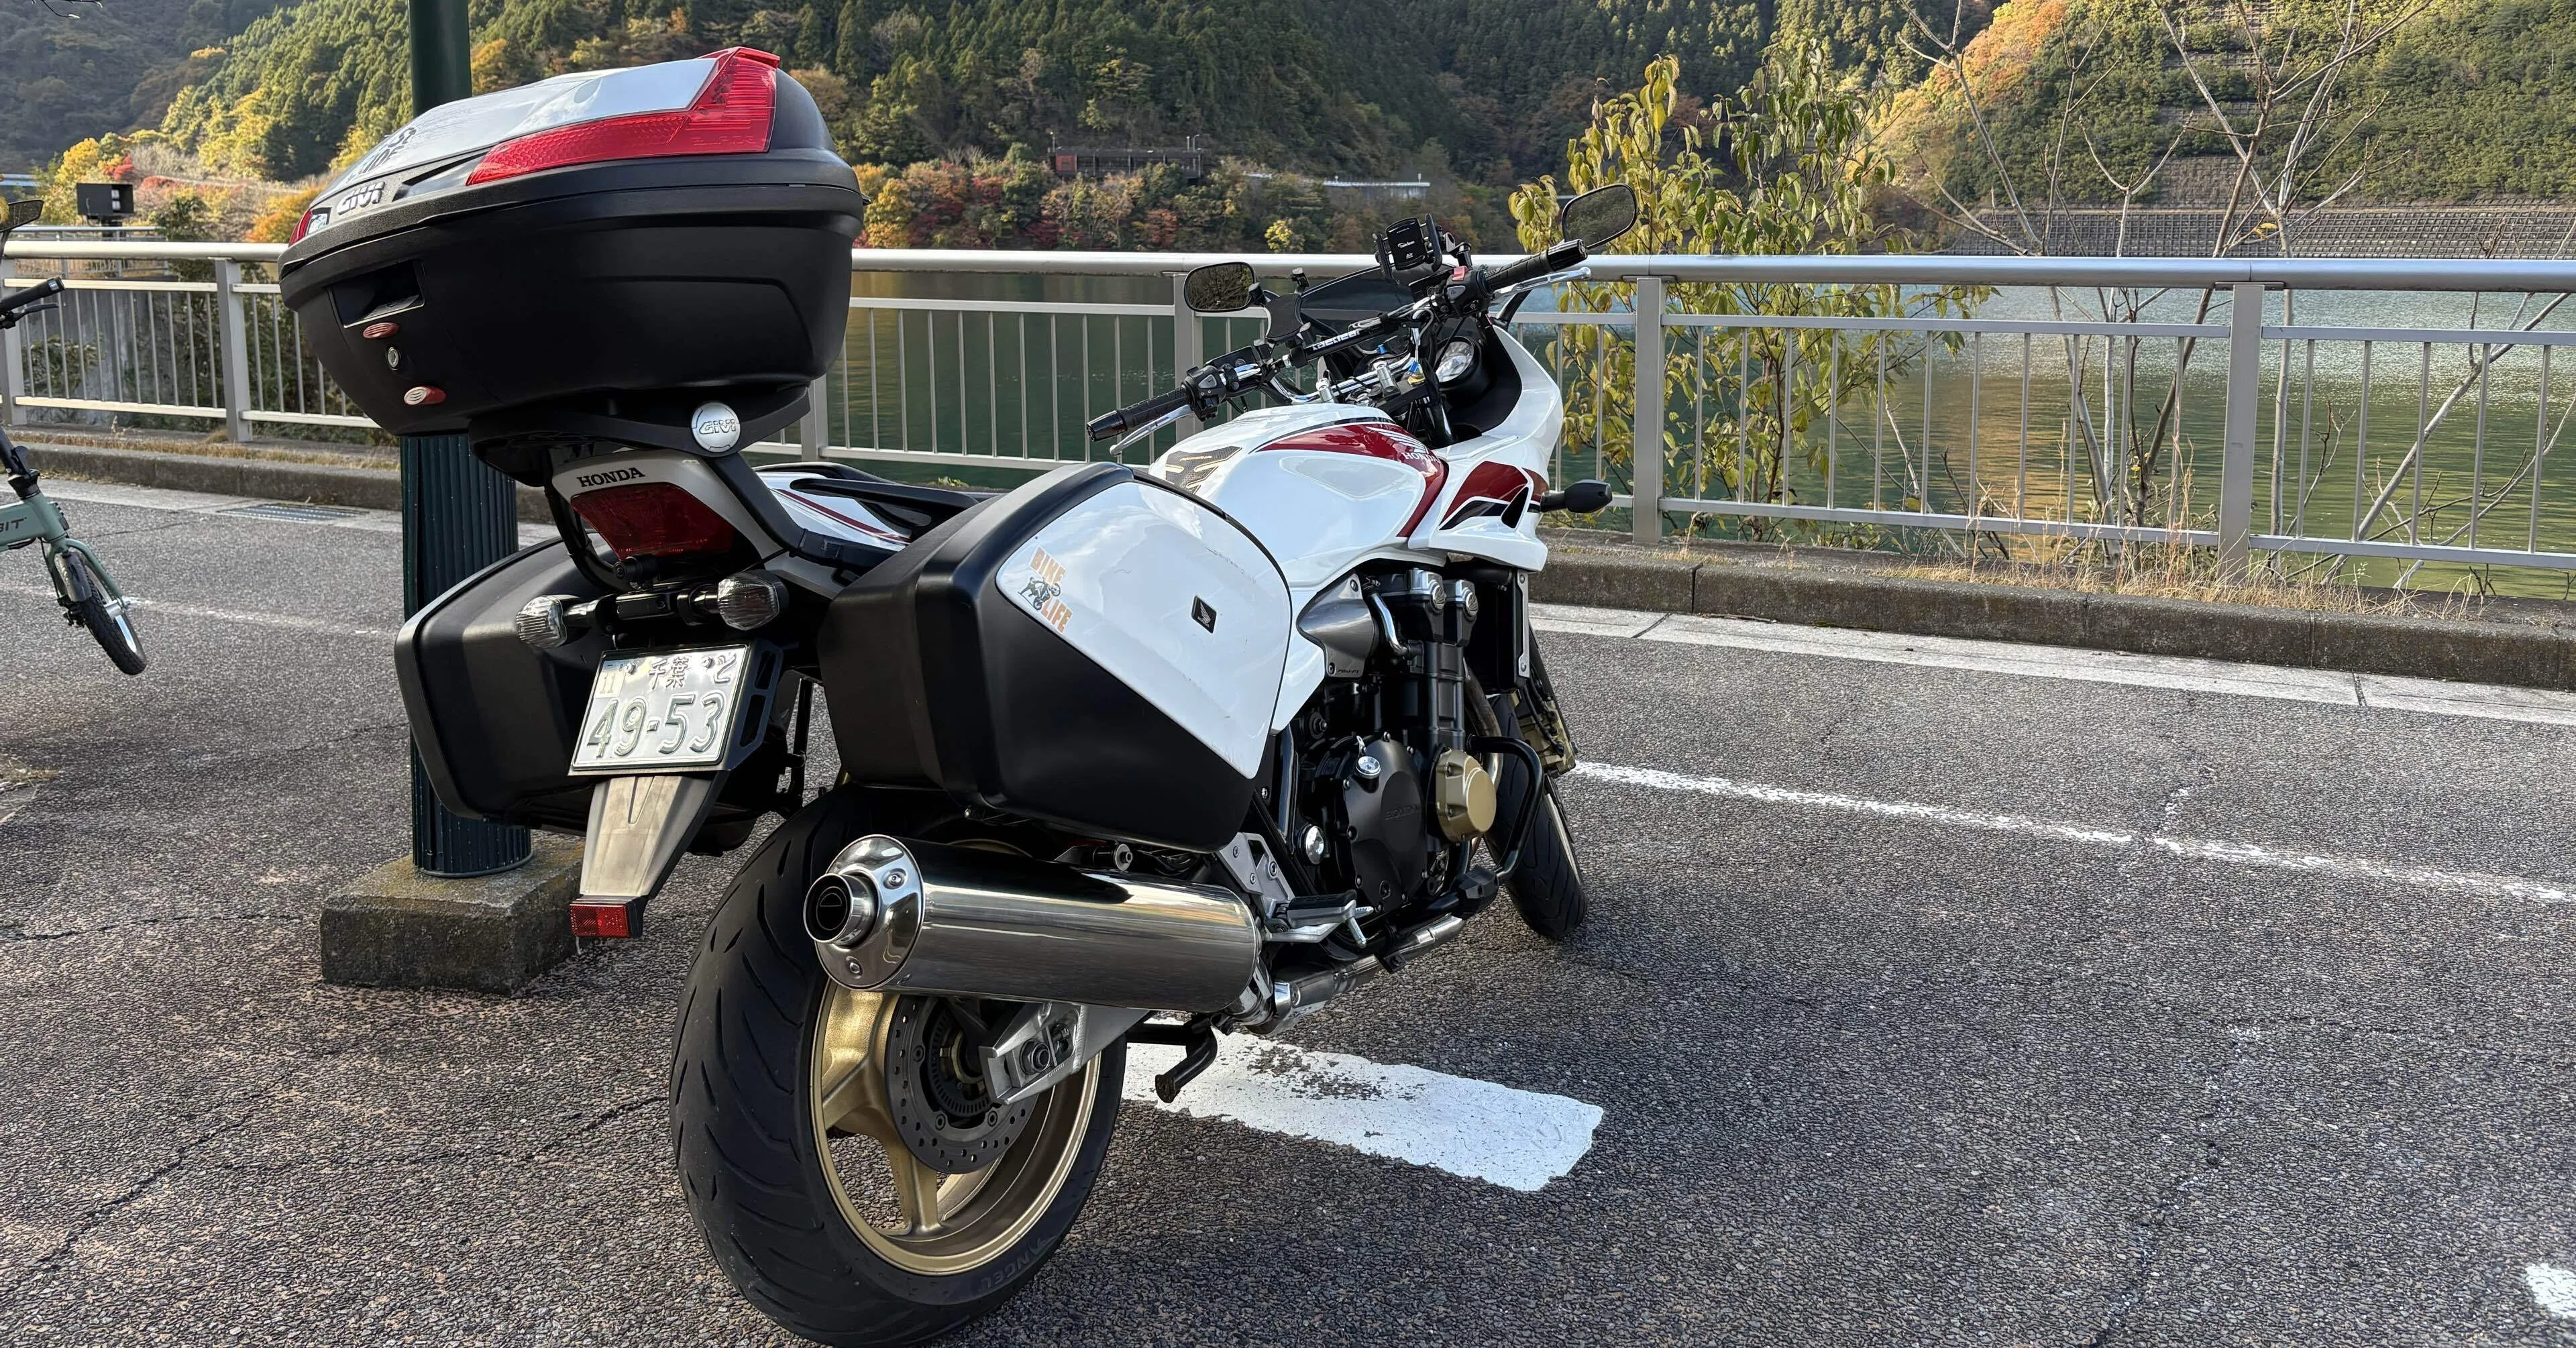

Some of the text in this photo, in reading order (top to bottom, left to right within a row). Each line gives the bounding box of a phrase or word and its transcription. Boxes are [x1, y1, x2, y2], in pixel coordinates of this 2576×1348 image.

[337, 182, 385, 215] GIVI
[699, 418, 736, 435] GIVI
[1401, 451, 1440, 463] HONDA
[577, 467, 645, 488] HONDA
[1030, 547, 1066, 586] BIKE
[1040, 597, 1073, 633] LIFE
[649, 656, 690, 691] 千葉
[587, 691, 727, 759] 49-53
[981, 1235, 1058, 1291] ANGEL
